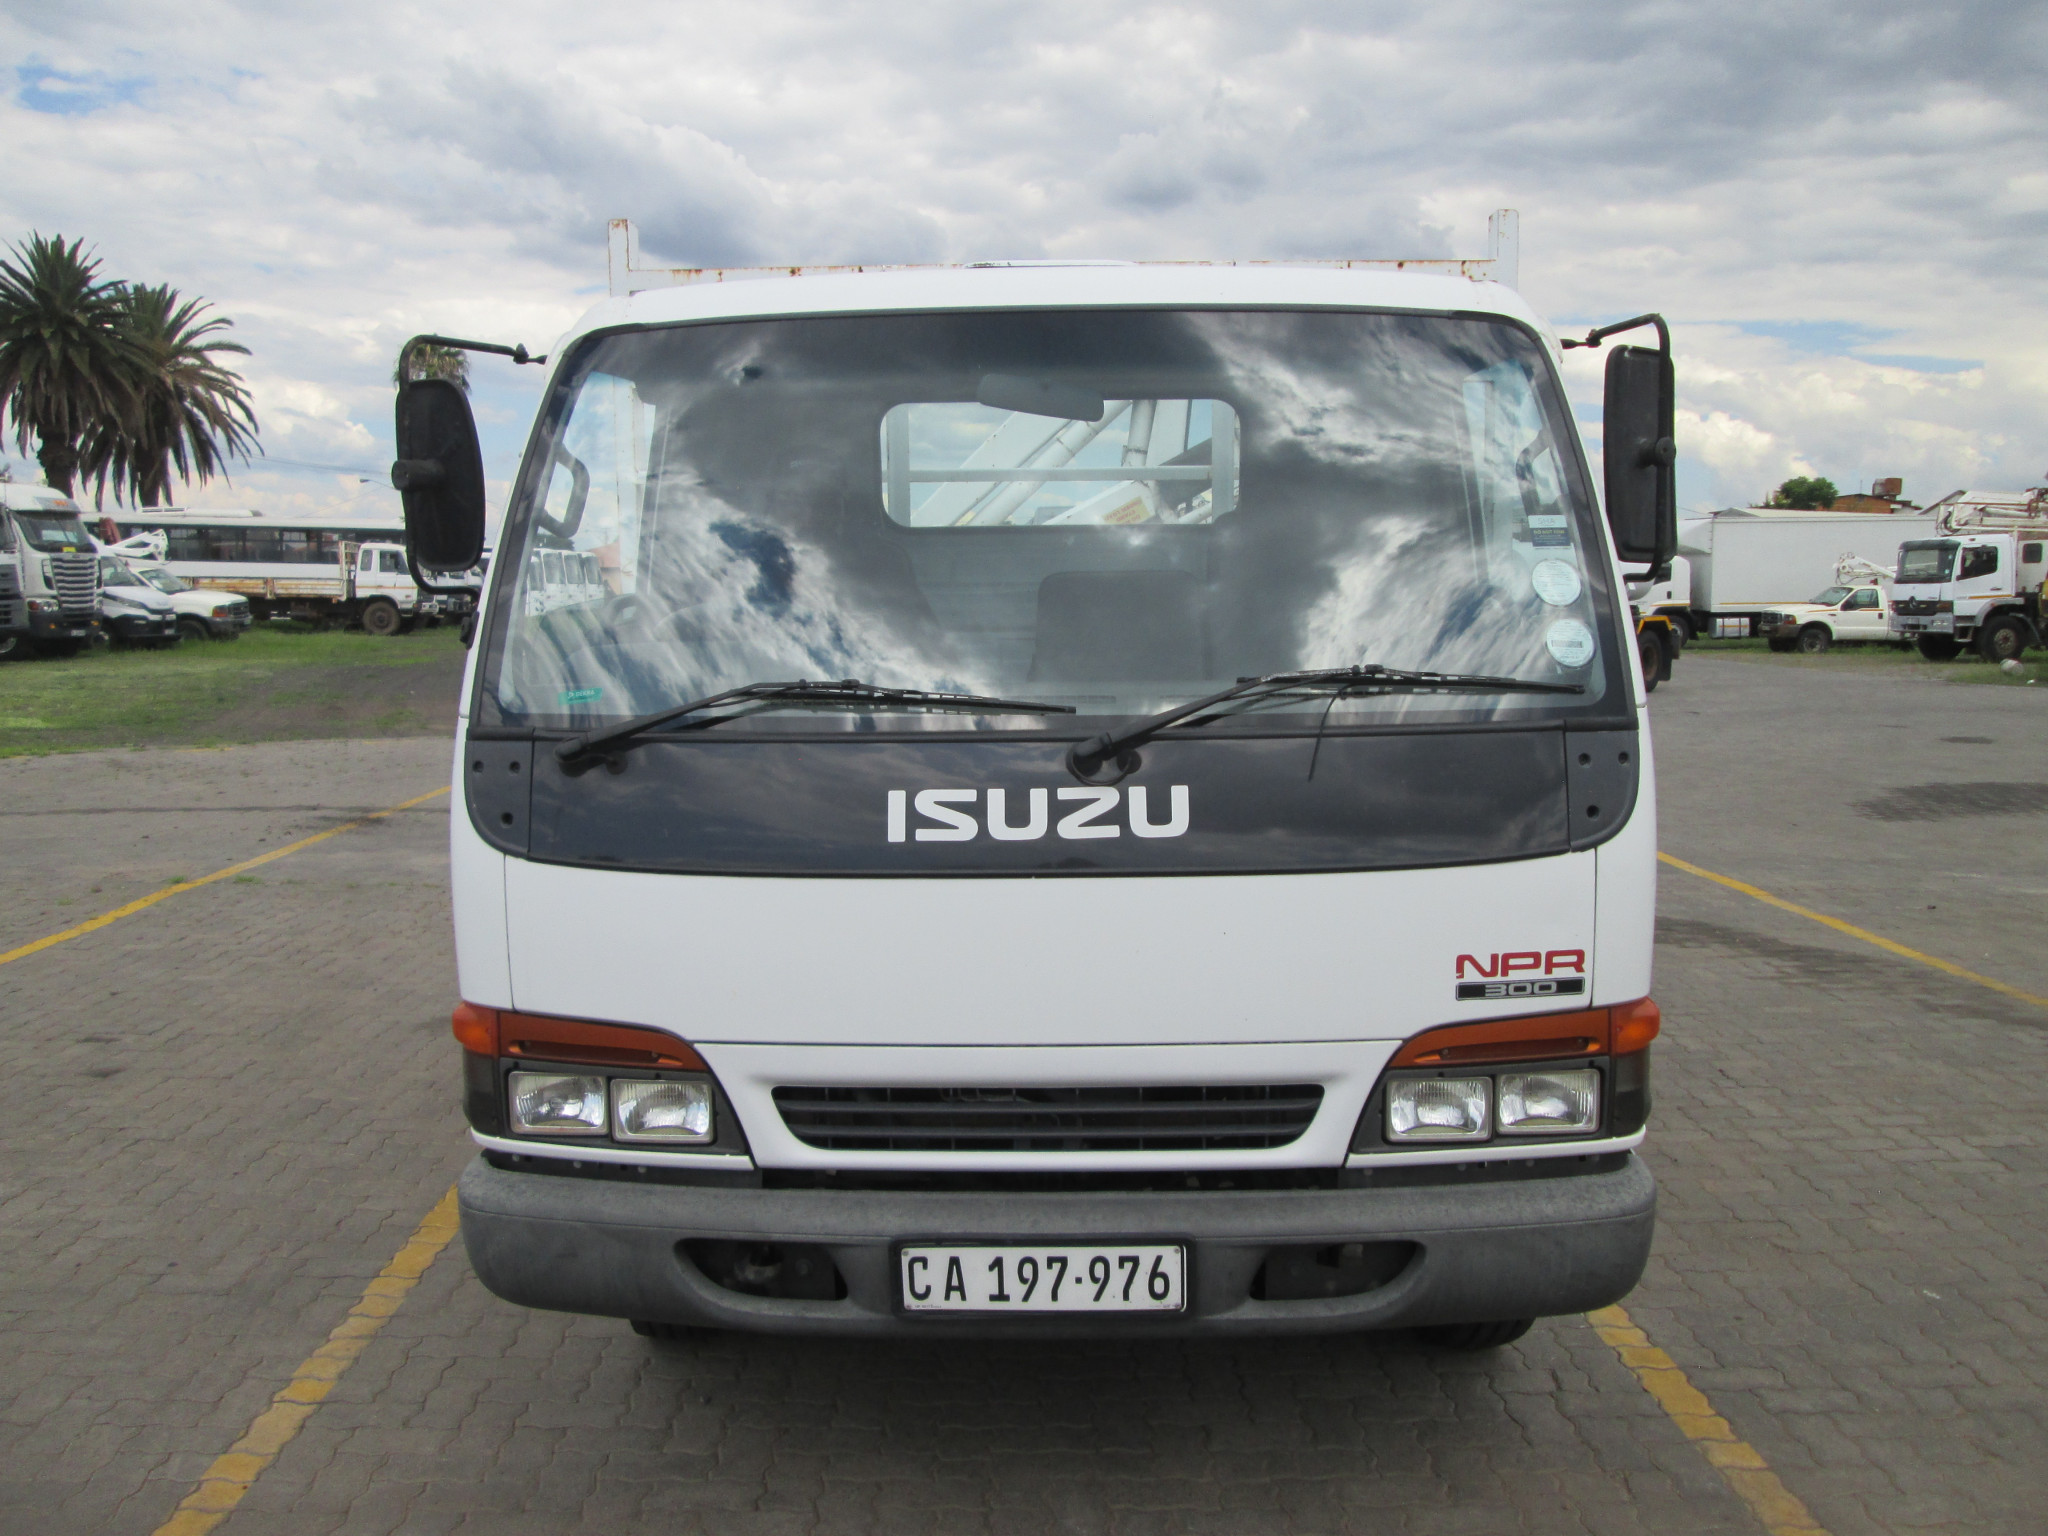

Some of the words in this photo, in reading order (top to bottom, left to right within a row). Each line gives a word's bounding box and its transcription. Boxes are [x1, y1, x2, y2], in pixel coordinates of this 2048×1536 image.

[887, 785, 1190, 843] ISUZU
[1456, 949, 1586, 979] NPR
[1484, 981, 1558, 997] 300
